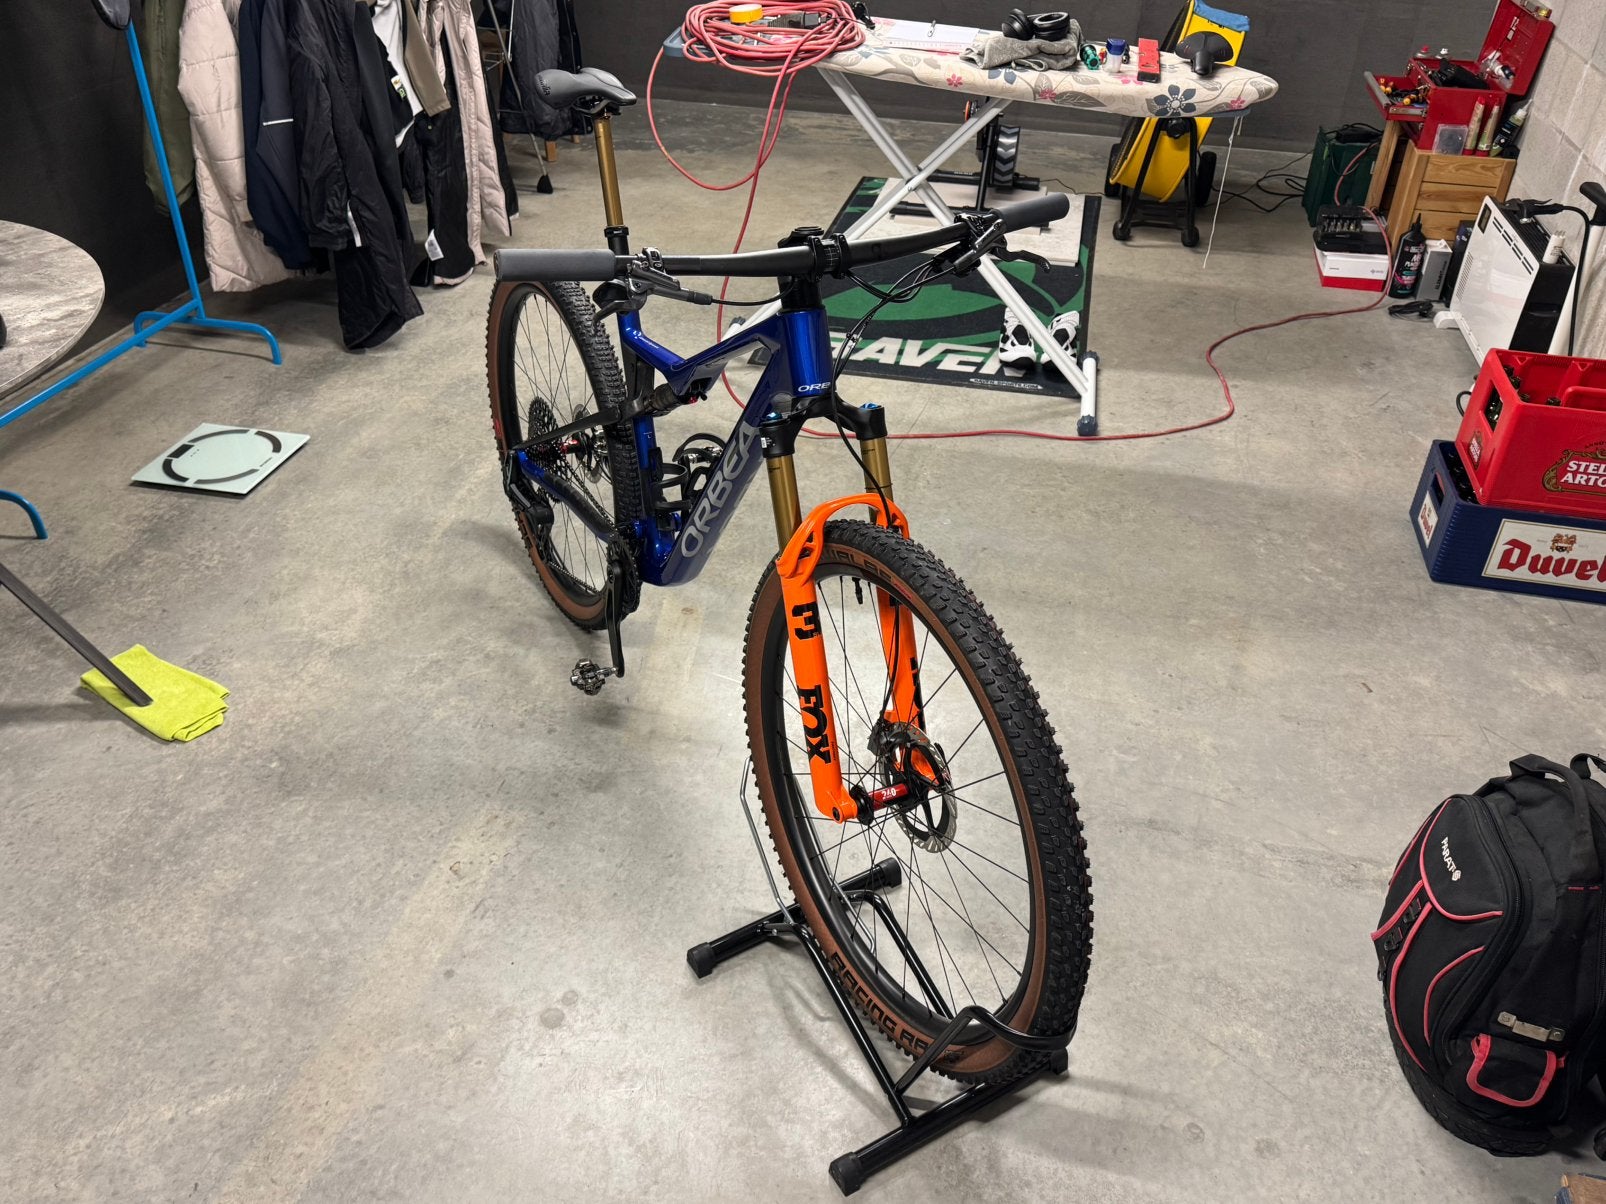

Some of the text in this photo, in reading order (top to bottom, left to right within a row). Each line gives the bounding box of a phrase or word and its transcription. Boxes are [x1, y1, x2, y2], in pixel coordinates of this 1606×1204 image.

[797, 381, 831, 392] ORB
[681, 420, 760, 558] ORBEA
[1560, 472, 1606, 488] ARTO
[1566, 460, 1606, 475] STEL
[797, 684, 832, 765] FOX
[831, 951, 898, 1035] RACING
